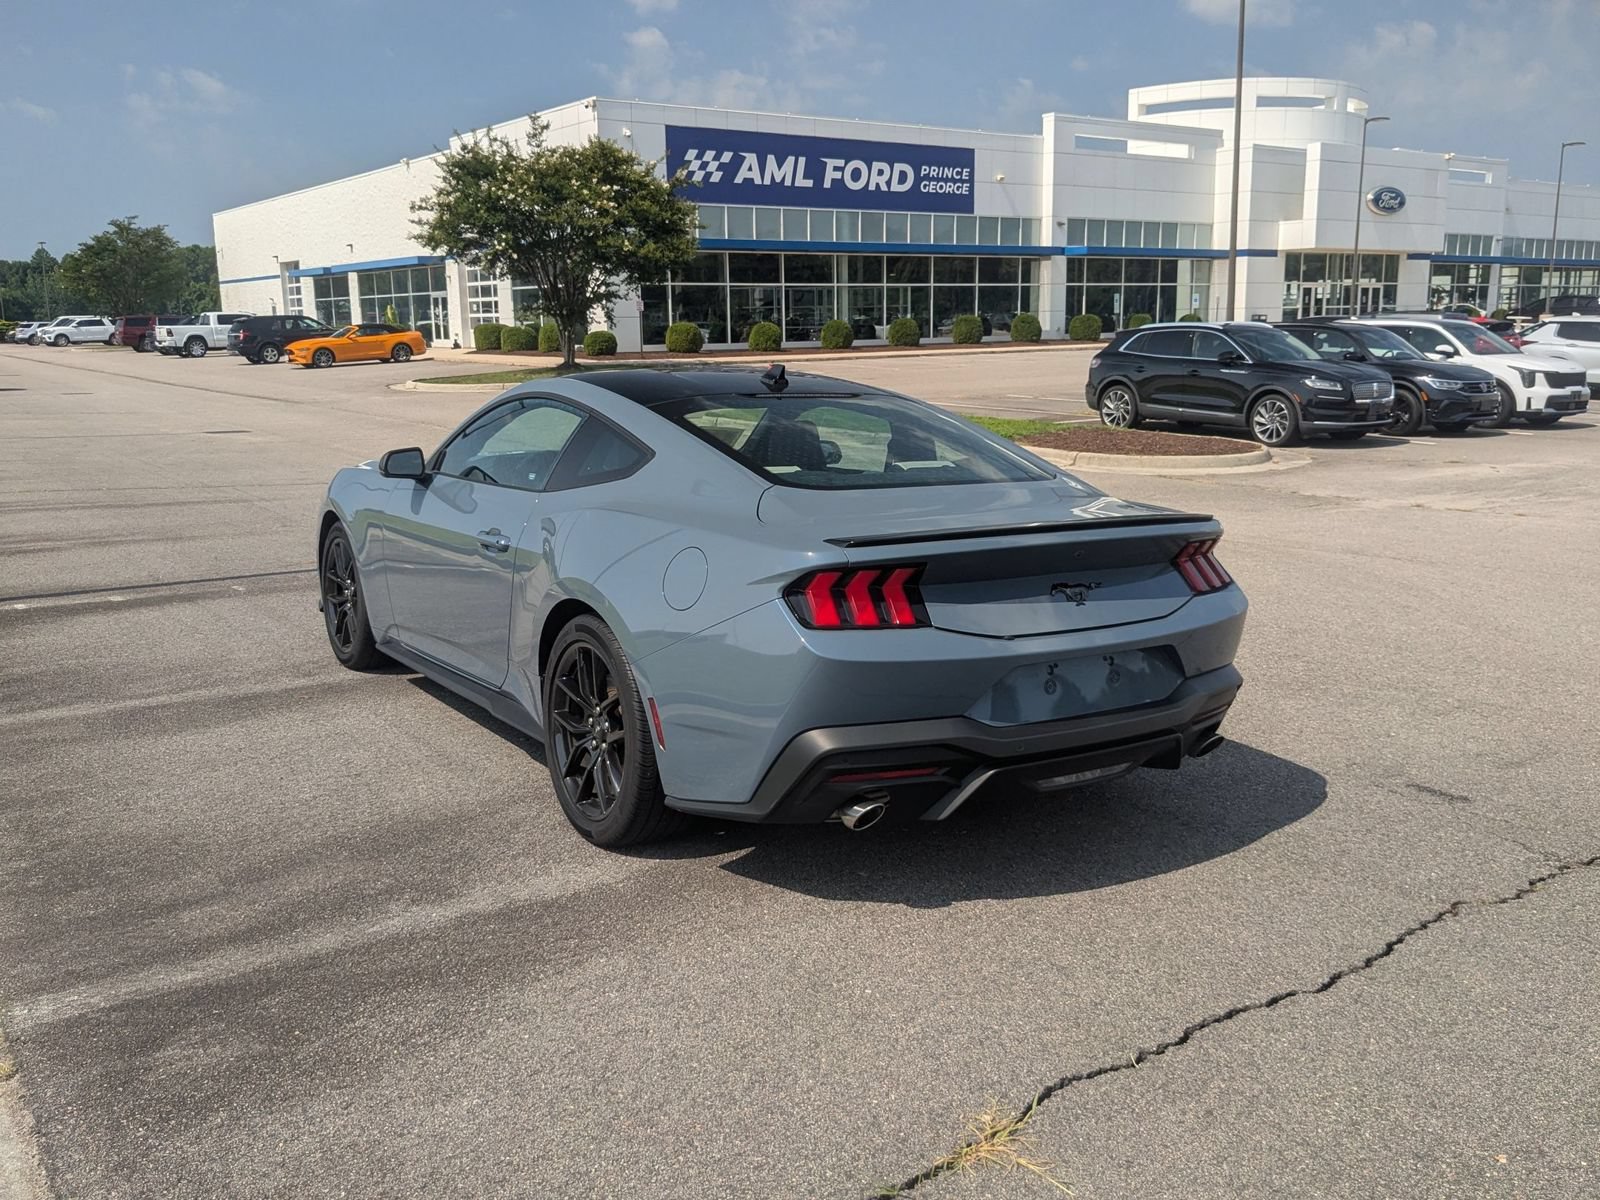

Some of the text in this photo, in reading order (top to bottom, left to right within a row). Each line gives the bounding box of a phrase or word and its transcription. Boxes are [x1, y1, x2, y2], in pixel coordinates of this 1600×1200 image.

[733, 152, 914, 192] AML FORD
[920, 165, 970, 180] PRINCE
[920, 181, 970, 195] GEORGE
[1379, 192, 1401, 208] Ford
